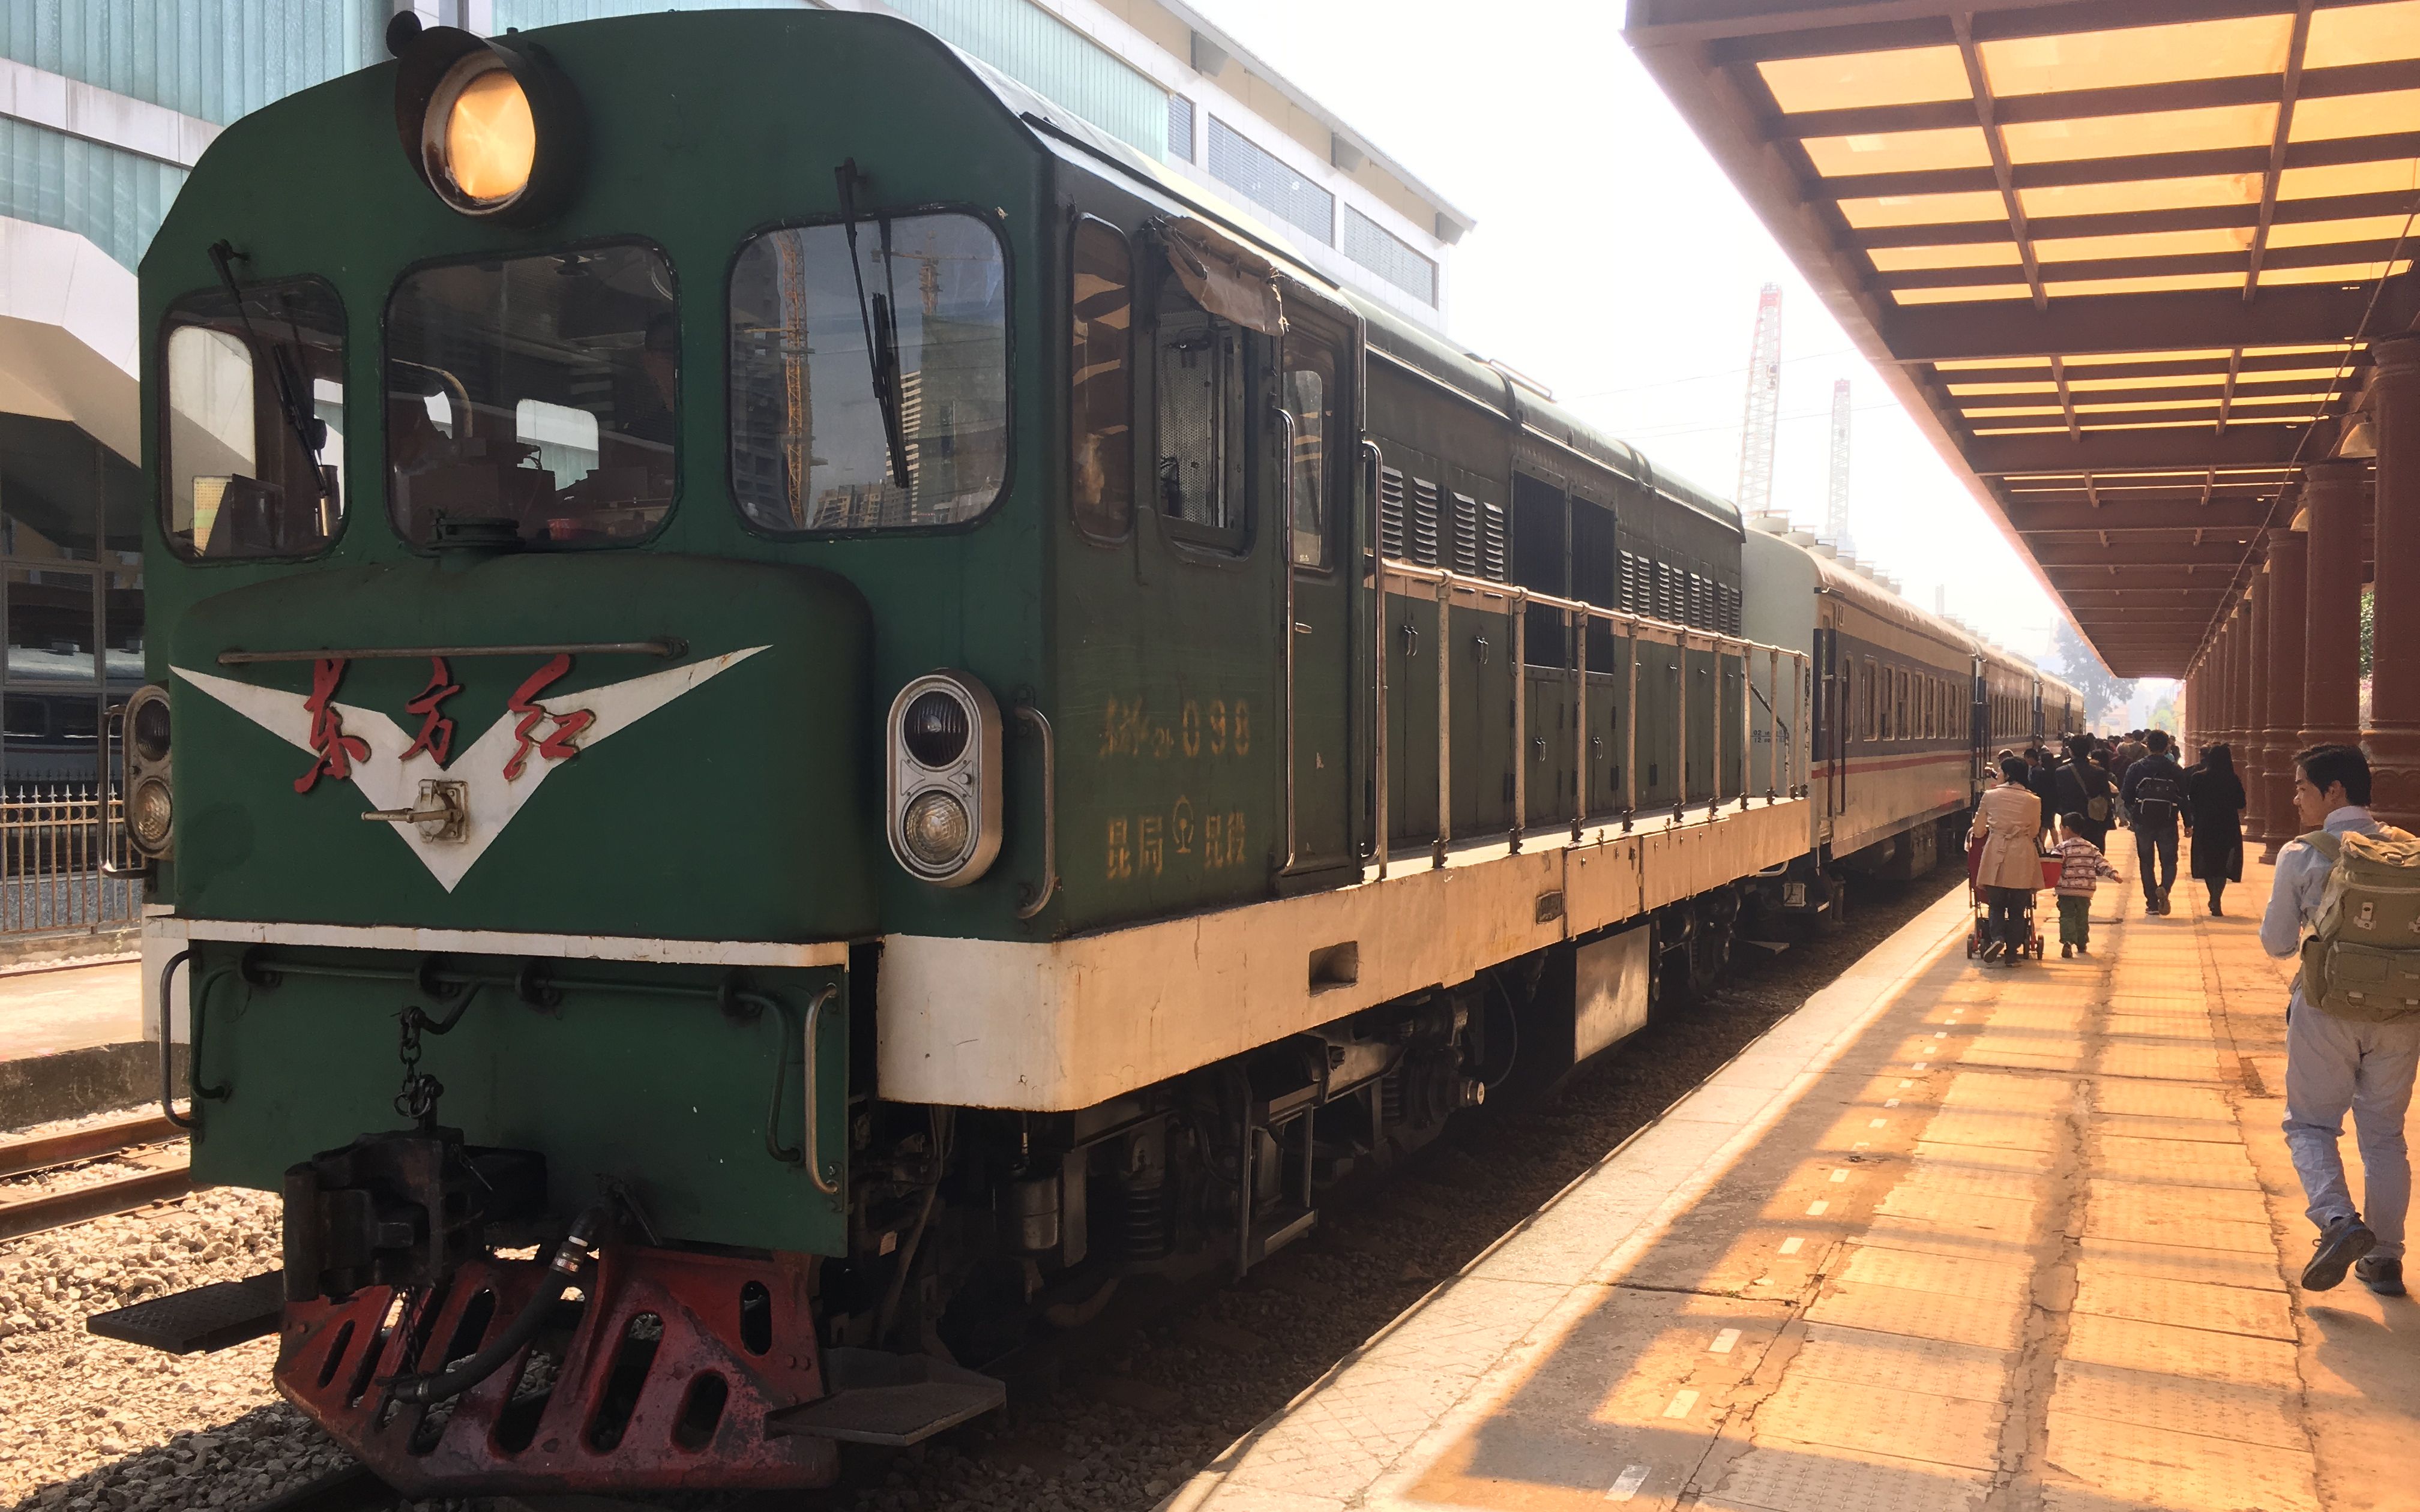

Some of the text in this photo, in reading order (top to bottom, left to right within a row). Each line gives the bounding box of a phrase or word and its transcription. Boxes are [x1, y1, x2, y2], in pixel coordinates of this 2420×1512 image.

[293, 653, 598, 793] 东方红
[1182, 699, 1250, 758] 098
[1107, 815, 1163, 880] 昆局
